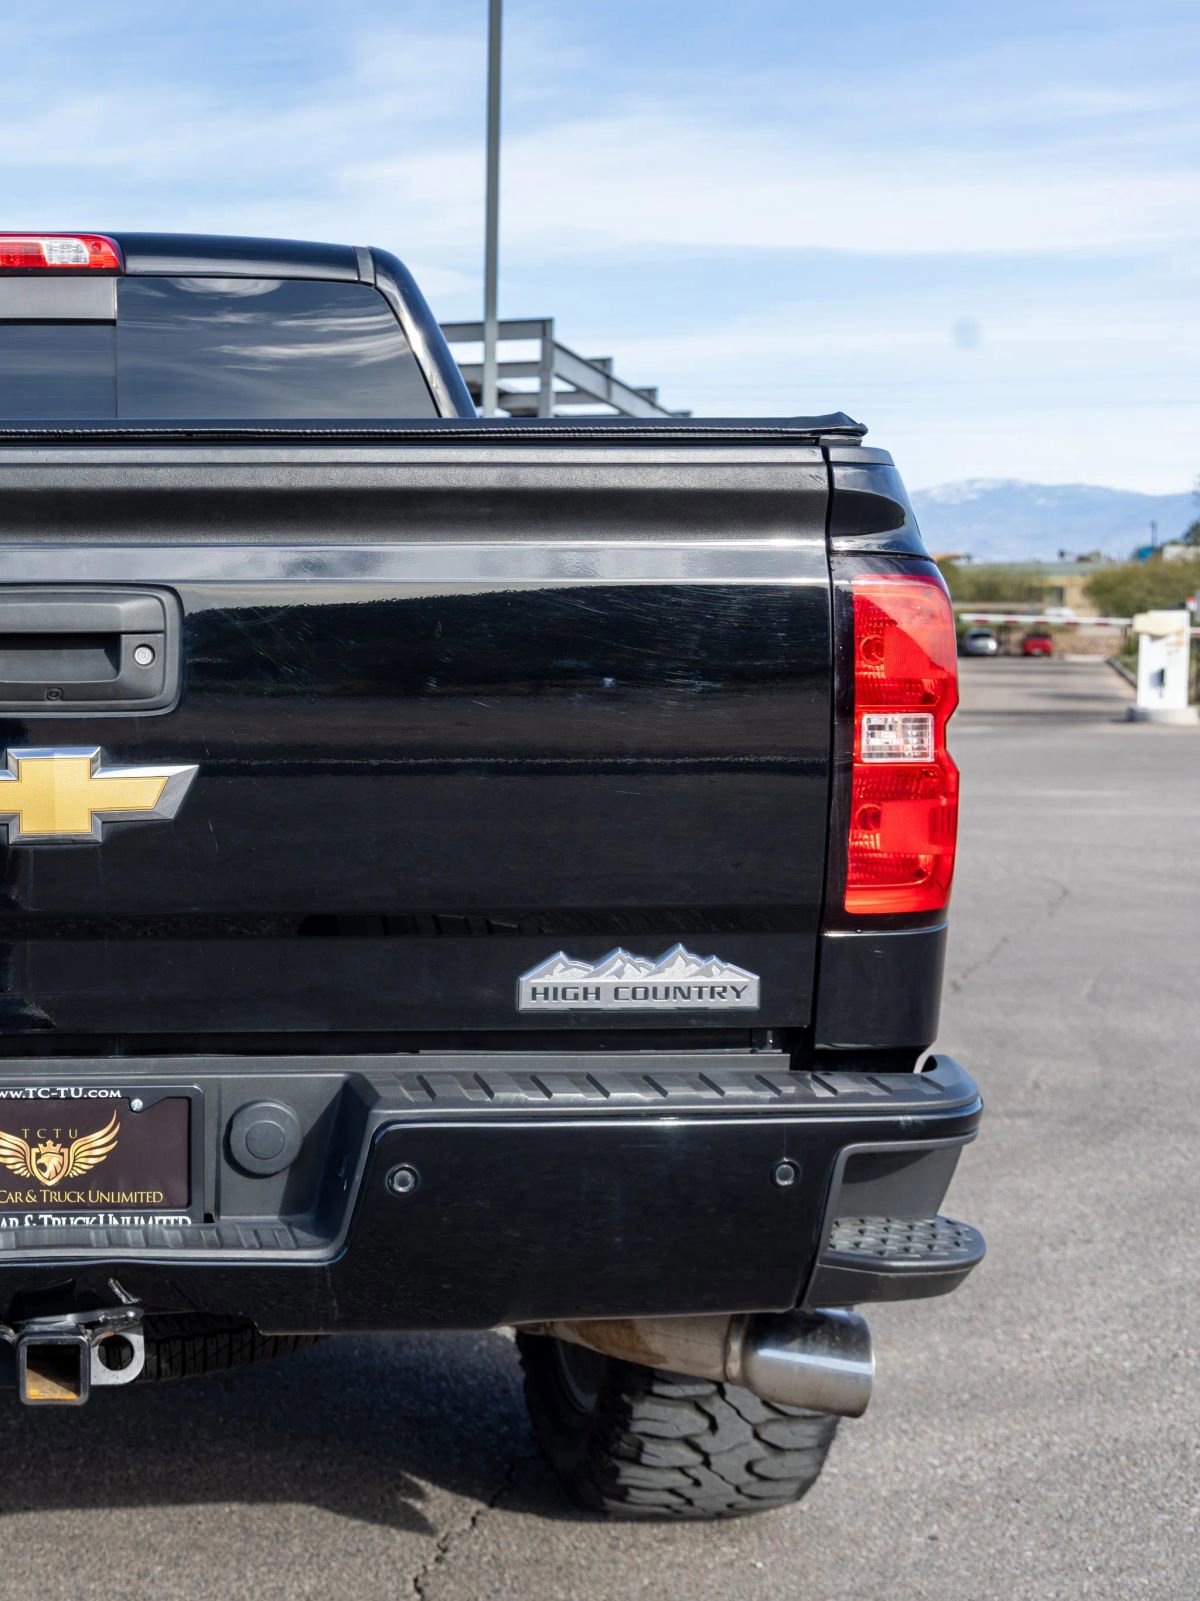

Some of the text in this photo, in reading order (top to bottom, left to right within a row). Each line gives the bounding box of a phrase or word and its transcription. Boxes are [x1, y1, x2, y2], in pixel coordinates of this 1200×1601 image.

[531, 985, 749, 1001] HIGH COUNTRY
[25, 1189, 37, 1203] &
[39, 1190, 86, 1203] TRUCK
[88, 1190, 164, 1203] UNLIMITED
